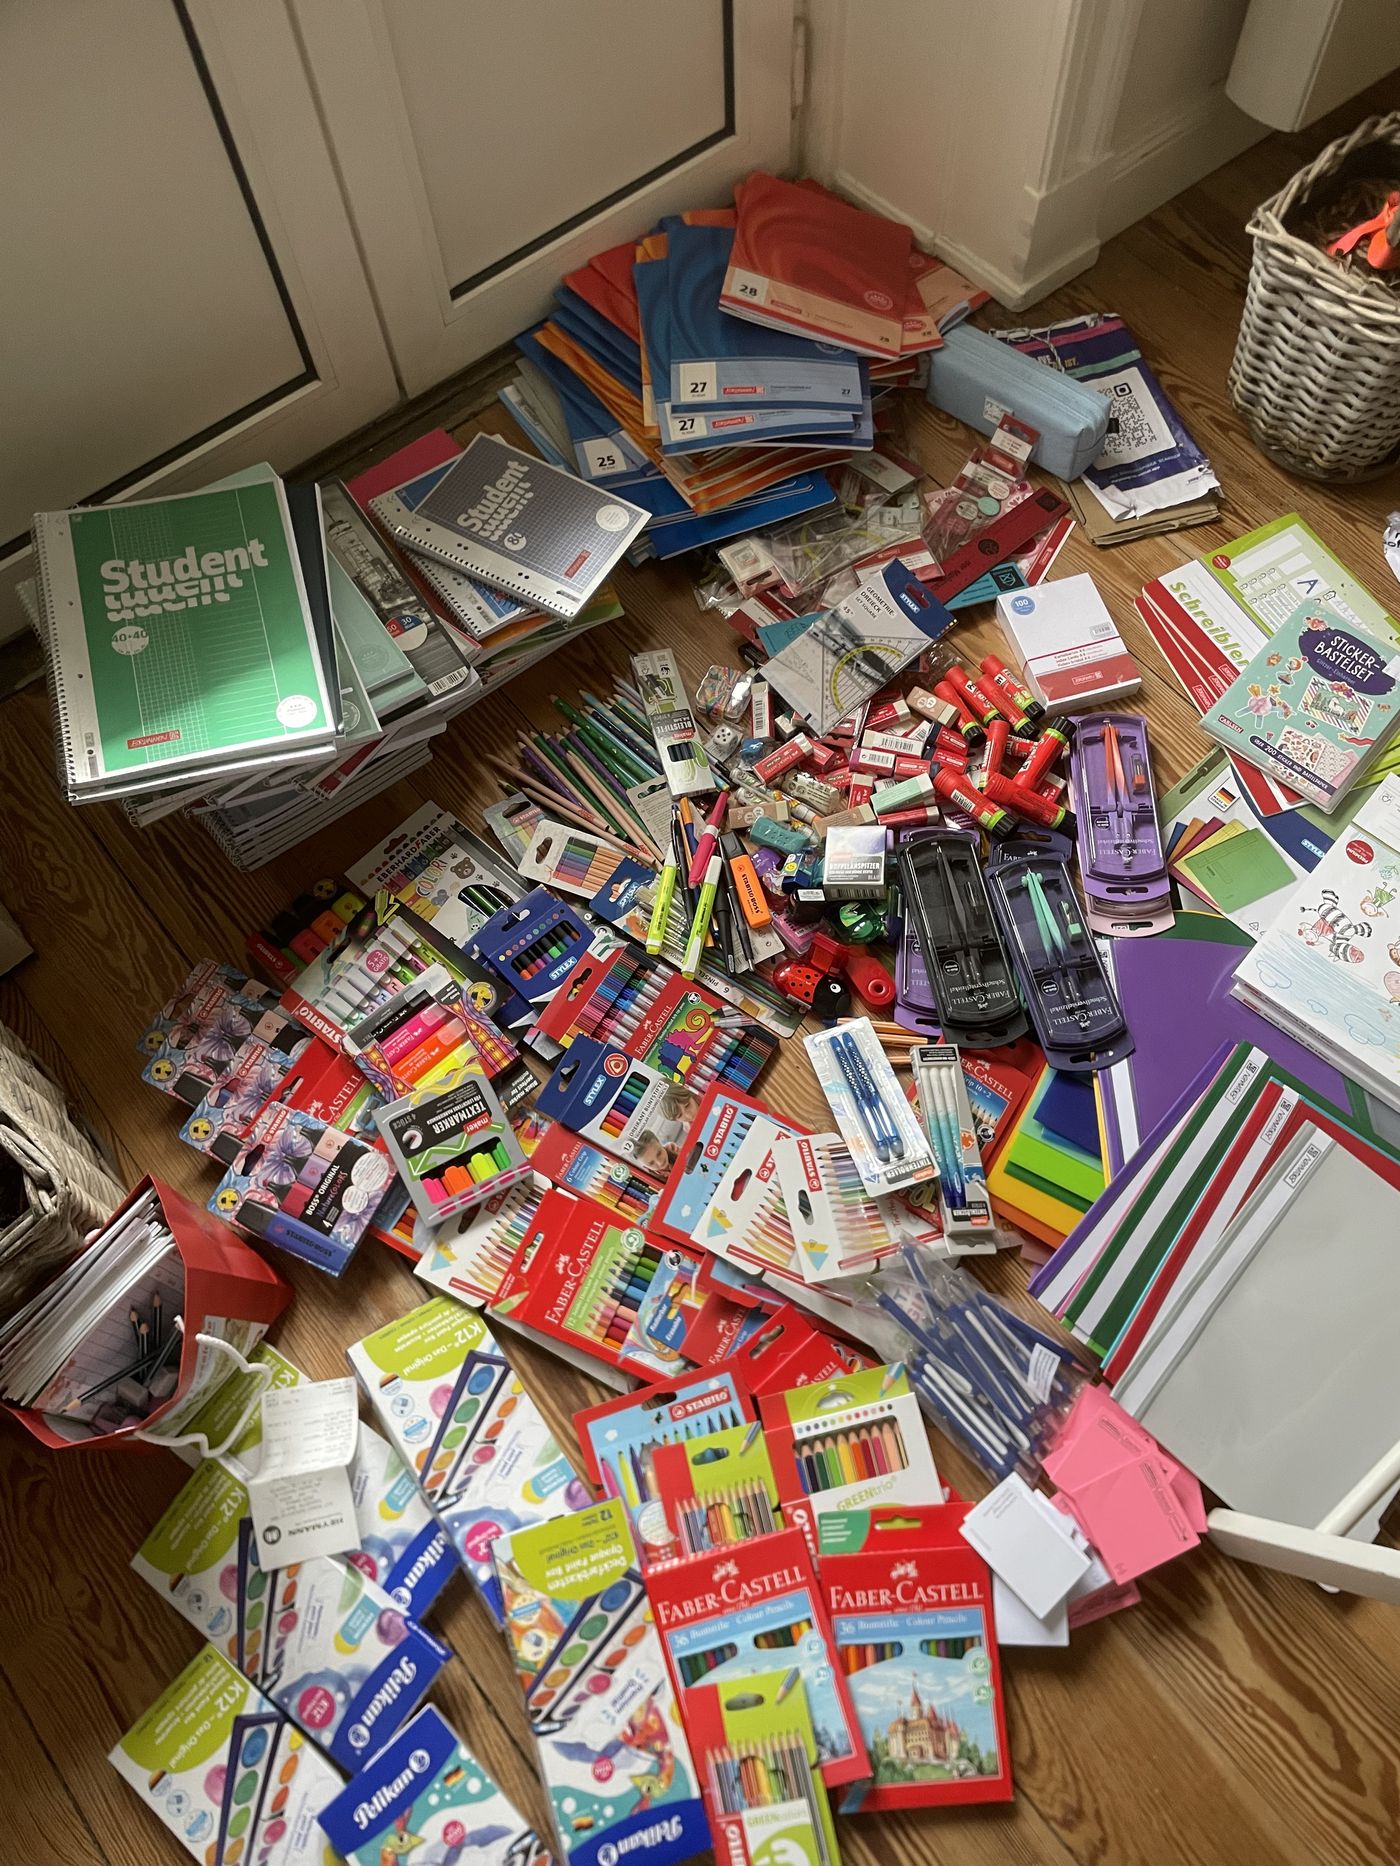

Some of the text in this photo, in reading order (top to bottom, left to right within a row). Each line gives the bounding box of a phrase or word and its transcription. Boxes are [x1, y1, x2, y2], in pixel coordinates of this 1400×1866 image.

[739, 284, 757, 297] 28
[690, 382, 707, 393] 27
[679, 419, 696, 431] 27
[597, 455, 615, 467] 25
[456, 460, 531, 531] Student
[100, 538, 269, 593] Student
[859, 590, 882, 613] DREIECK
[864, 586, 897, 616] GEOMETRIE-
[898, 593, 920, 613] STYLEX
[1013, 598, 1029, 608] 100
[400, 616, 411, 625] 30
[1312, 640, 1375, 683] BASTELSET
[1328, 634, 1383, 671] STICKER-
[655, 721, 691, 732] BLEISTIFTE
[1217, 715, 1243, 733] CARLSEN
[1263, 745, 1277, 755] 200
[741, 873, 760, 913] STABILO BOSS
[550, 957, 576, 979] STYLEX
[696, 970, 719, 986] PINSEL
[300, 1006, 342, 1044] STABILO
[633, 1003, 675, 1054] FABER-CASTELL
[1052, 1006, 1112, 1026] FABER-CASTELL
[244, 1046, 262, 1069] STABILO
[385, 1034, 414, 1059] FABER-CAST
[507, 1079, 538, 1105] Black marker
[516, 1074, 534, 1090] perfect
[584, 1075, 605, 1105] STYLEX
[960, 1057, 1015, 1101] ER-CASTELL
[319, 1074, 362, 1123] CASTELL
[628, 1081, 663, 1137] DREIKANT BUNTSTIFTE
[268, 1109, 287, 1134] STABILO
[431, 1100, 486, 1134] TEXTMARKER
[464, 1115, 489, 1132] maker
[711, 1106, 734, 1144] STABILO
[622, 1141, 632, 1152] 12
[799, 1141, 817, 1177] STABILO
[317, 1163, 340, 1194] ORIGINAL
[884, 1158, 931, 1177] TINTENROLLER
[321, 1218, 333, 1229] 4
[541, 1218, 611, 1323] FABER-CASTELL
[649, 1303, 668, 1332] Radierbar
[664, 1315, 682, 1341] Erasable
[400, 1352, 434, 1375] Original
[431, 1344, 447, 1357] Das
[685, 1389, 728, 1414] STABILO
[657, 1564, 807, 1626] FABER-CASTELL
[829, 1580, 985, 1609] FABER-CASTELL
[361, 1656, 416, 1746] Pelikan
[165, 1733, 198, 1769] Original
[353, 1769, 415, 1831] Pelikan
[617, 1814, 683, 1856] Pelikan
